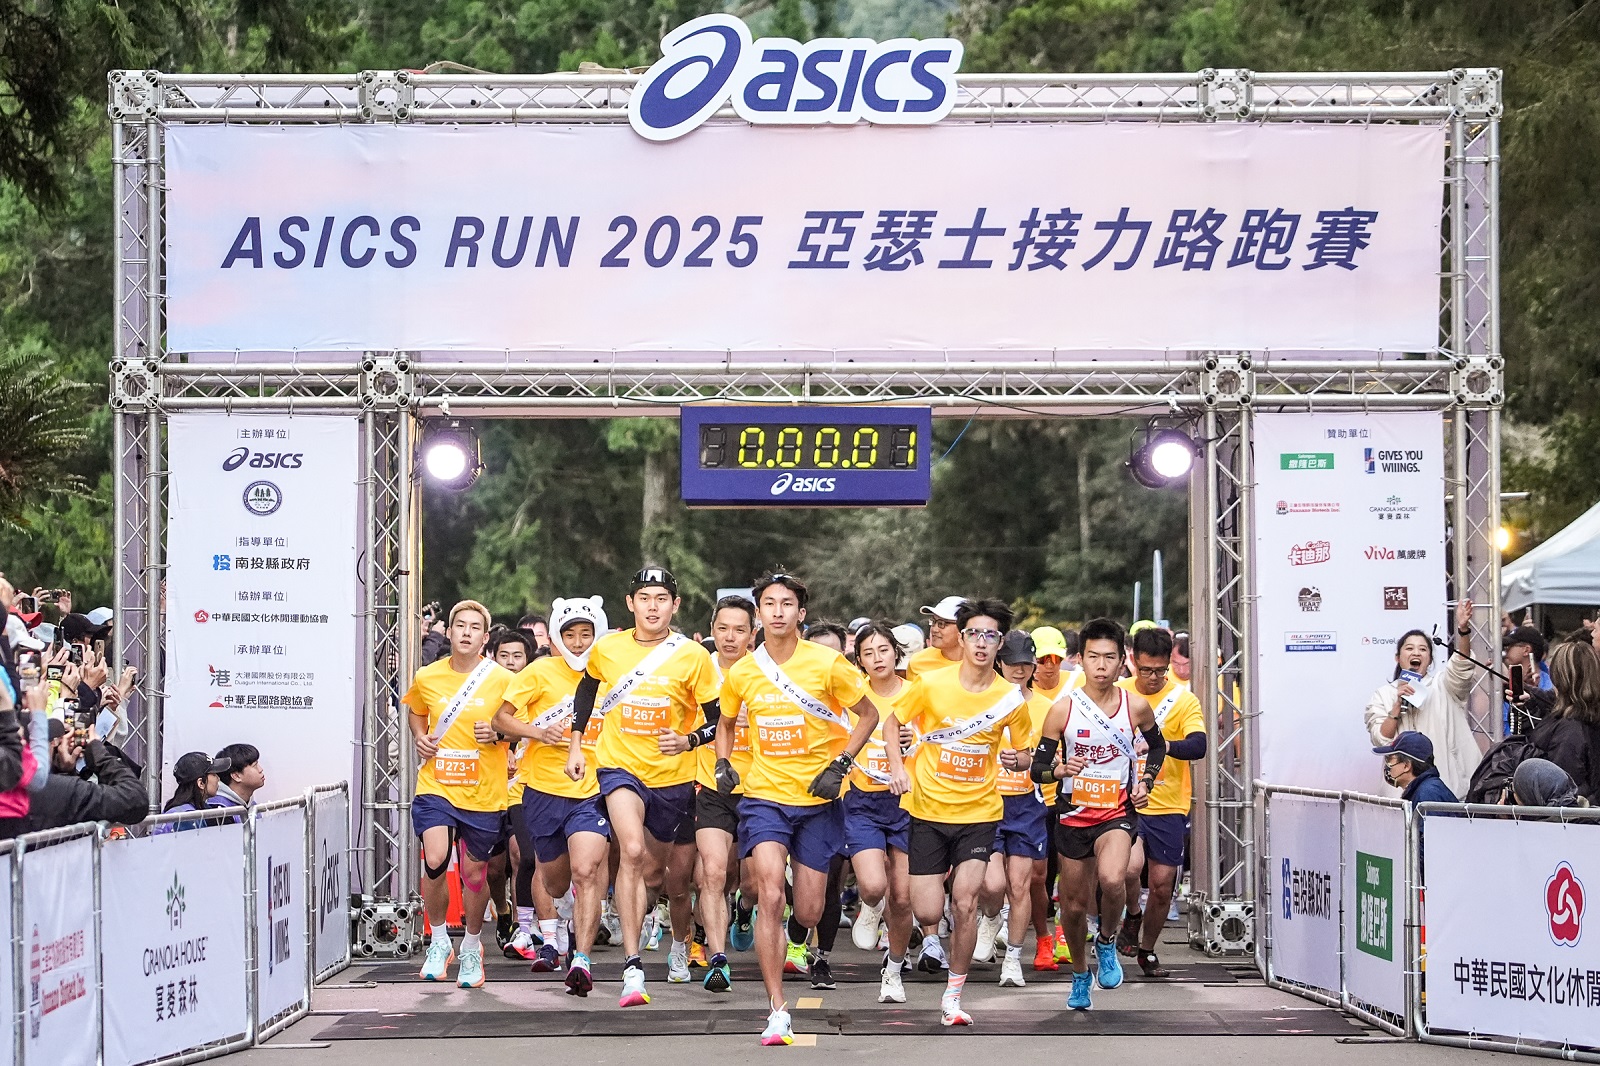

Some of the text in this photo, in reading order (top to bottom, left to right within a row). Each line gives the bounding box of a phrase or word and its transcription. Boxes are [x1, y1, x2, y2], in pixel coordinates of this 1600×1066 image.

[743, 49, 952, 112] asics
[221, 206, 1379, 271] ASICS RUN 2025 亞瑟士接力路跑賽
[241, 429, 287, 439] 主辦單位
[249, 453, 303, 468] asics
[1378, 450, 1423, 461] GIVES YOU
[1382, 463, 1420, 473] WIIINGS.
[792, 477, 836, 492] asics
[239, 537, 285, 547] 指導單位
[235, 557, 311, 570] 南投縣政府
[238, 591, 285, 601] 協辦單位
[237, 644, 284, 655] 承辦單位
[224, 694, 314, 706] 中華民國路跑協會
[753, 693, 793, 703] ASIC
[634, 709, 666, 720] 267-1
[769, 728, 802, 741] 268-1
[949, 720, 982, 737] ASICS
[446, 762, 475, 772] 273-1
[952, 755, 984, 768] 083-1
[1085, 781, 1117, 793] 061-1
[1292, 867, 1331, 920] 南投縣政府
[143, 936, 206, 977] GRANOLA HOUSE
